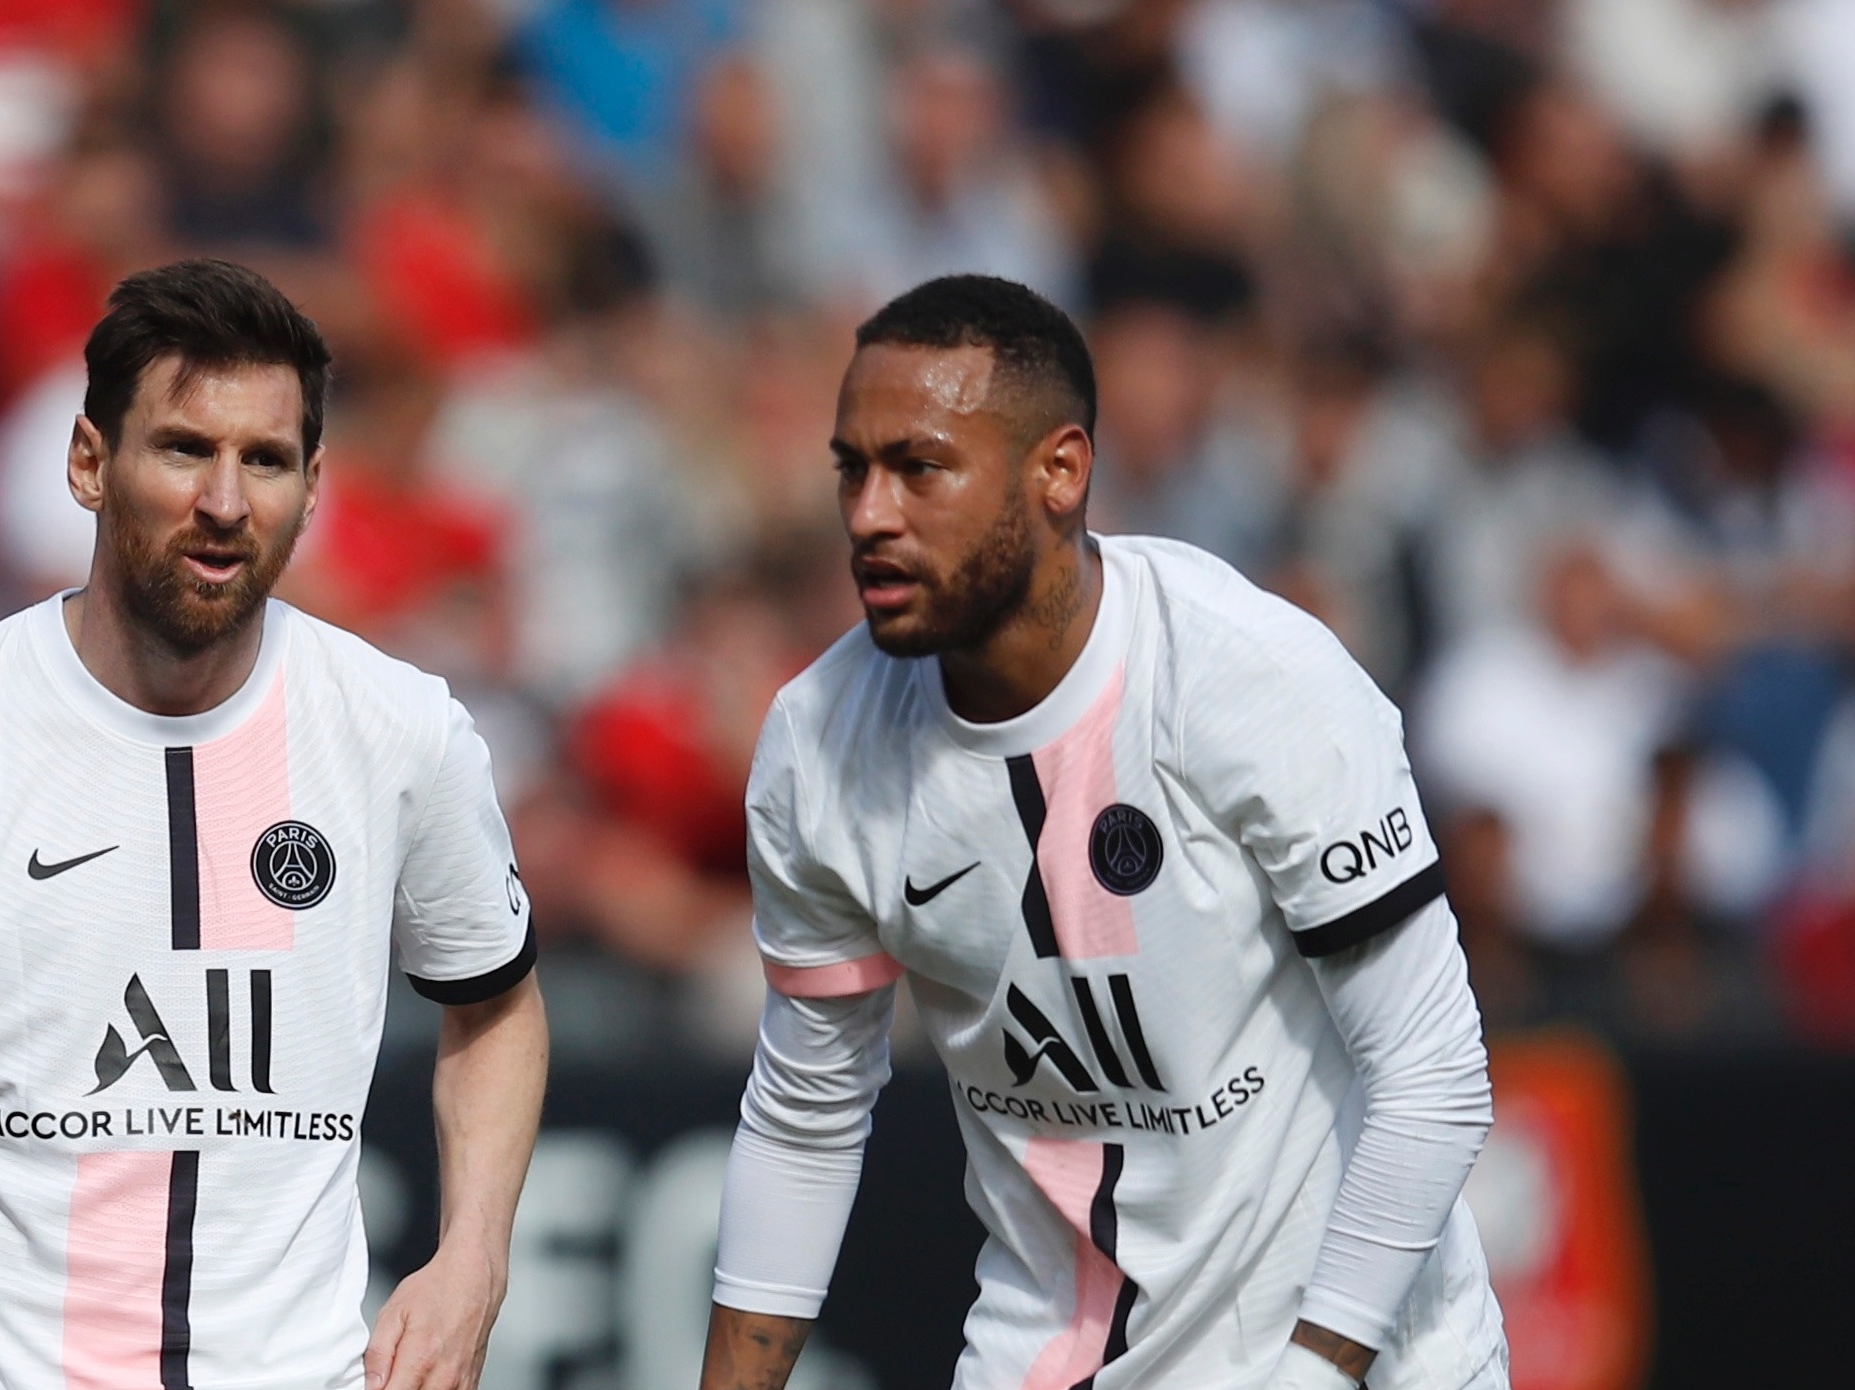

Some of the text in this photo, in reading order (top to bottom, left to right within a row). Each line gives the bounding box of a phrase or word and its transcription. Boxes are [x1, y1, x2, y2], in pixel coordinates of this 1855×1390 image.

[265, 827, 318, 848] PARIS
[1320, 806, 1413, 884] QNB
[126, 1107, 204, 1137] LIVE
[216, 1108, 354, 1142] LIMITLESS
[957, 1065, 1265, 1135] CCOR LIVE LIMITLESS
